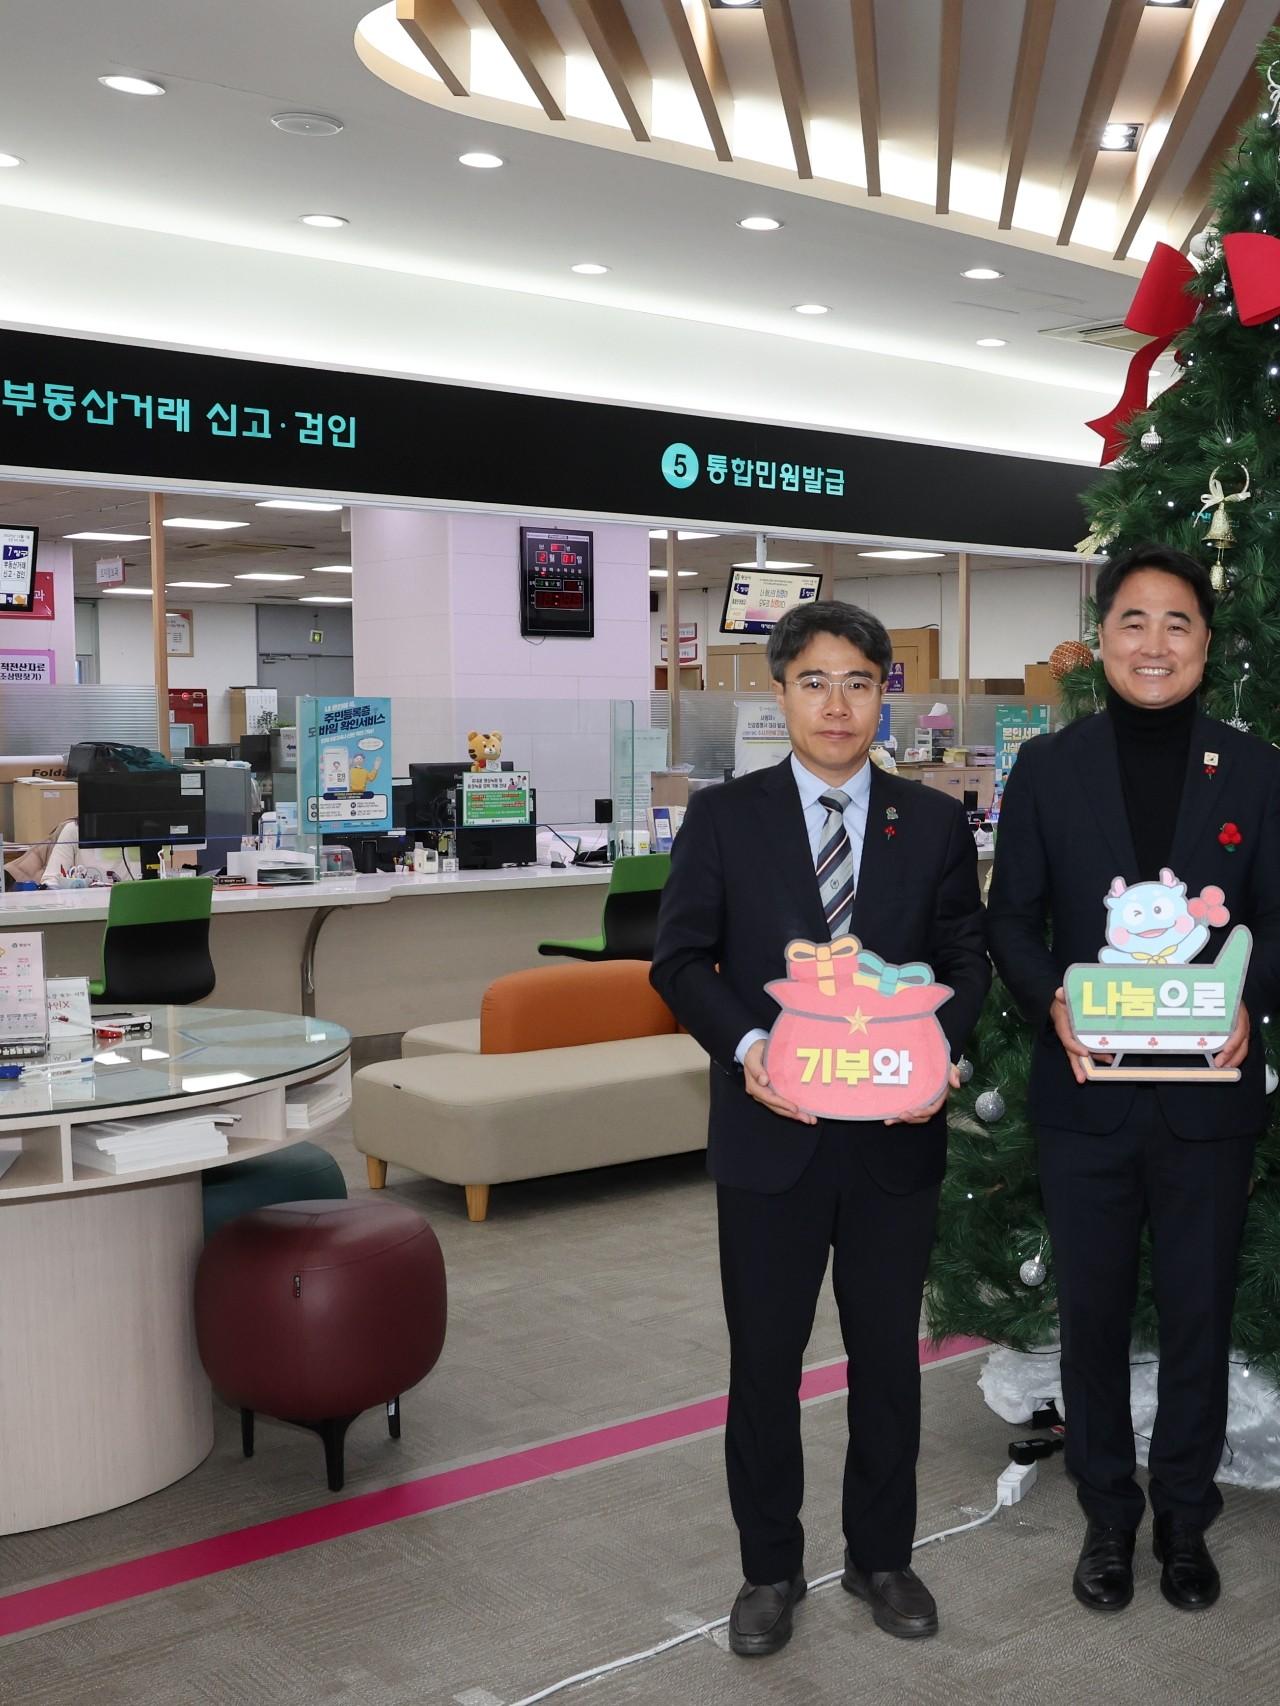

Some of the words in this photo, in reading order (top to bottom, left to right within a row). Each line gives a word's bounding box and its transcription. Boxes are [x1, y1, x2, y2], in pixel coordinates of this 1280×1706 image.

[2, 379, 190, 433] 부동산거래
[206, 402, 356, 449] 신고·검인
[673, 453, 687, 478] 5
[706, 453, 845, 497] 통합민원발급
[324, 705, 371, 724] 주민등록증
[340, 713, 386, 732] 확인서비스
[1083, 979, 1227, 1018] 나눔으로
[796, 1047, 913, 1086] 기부와
